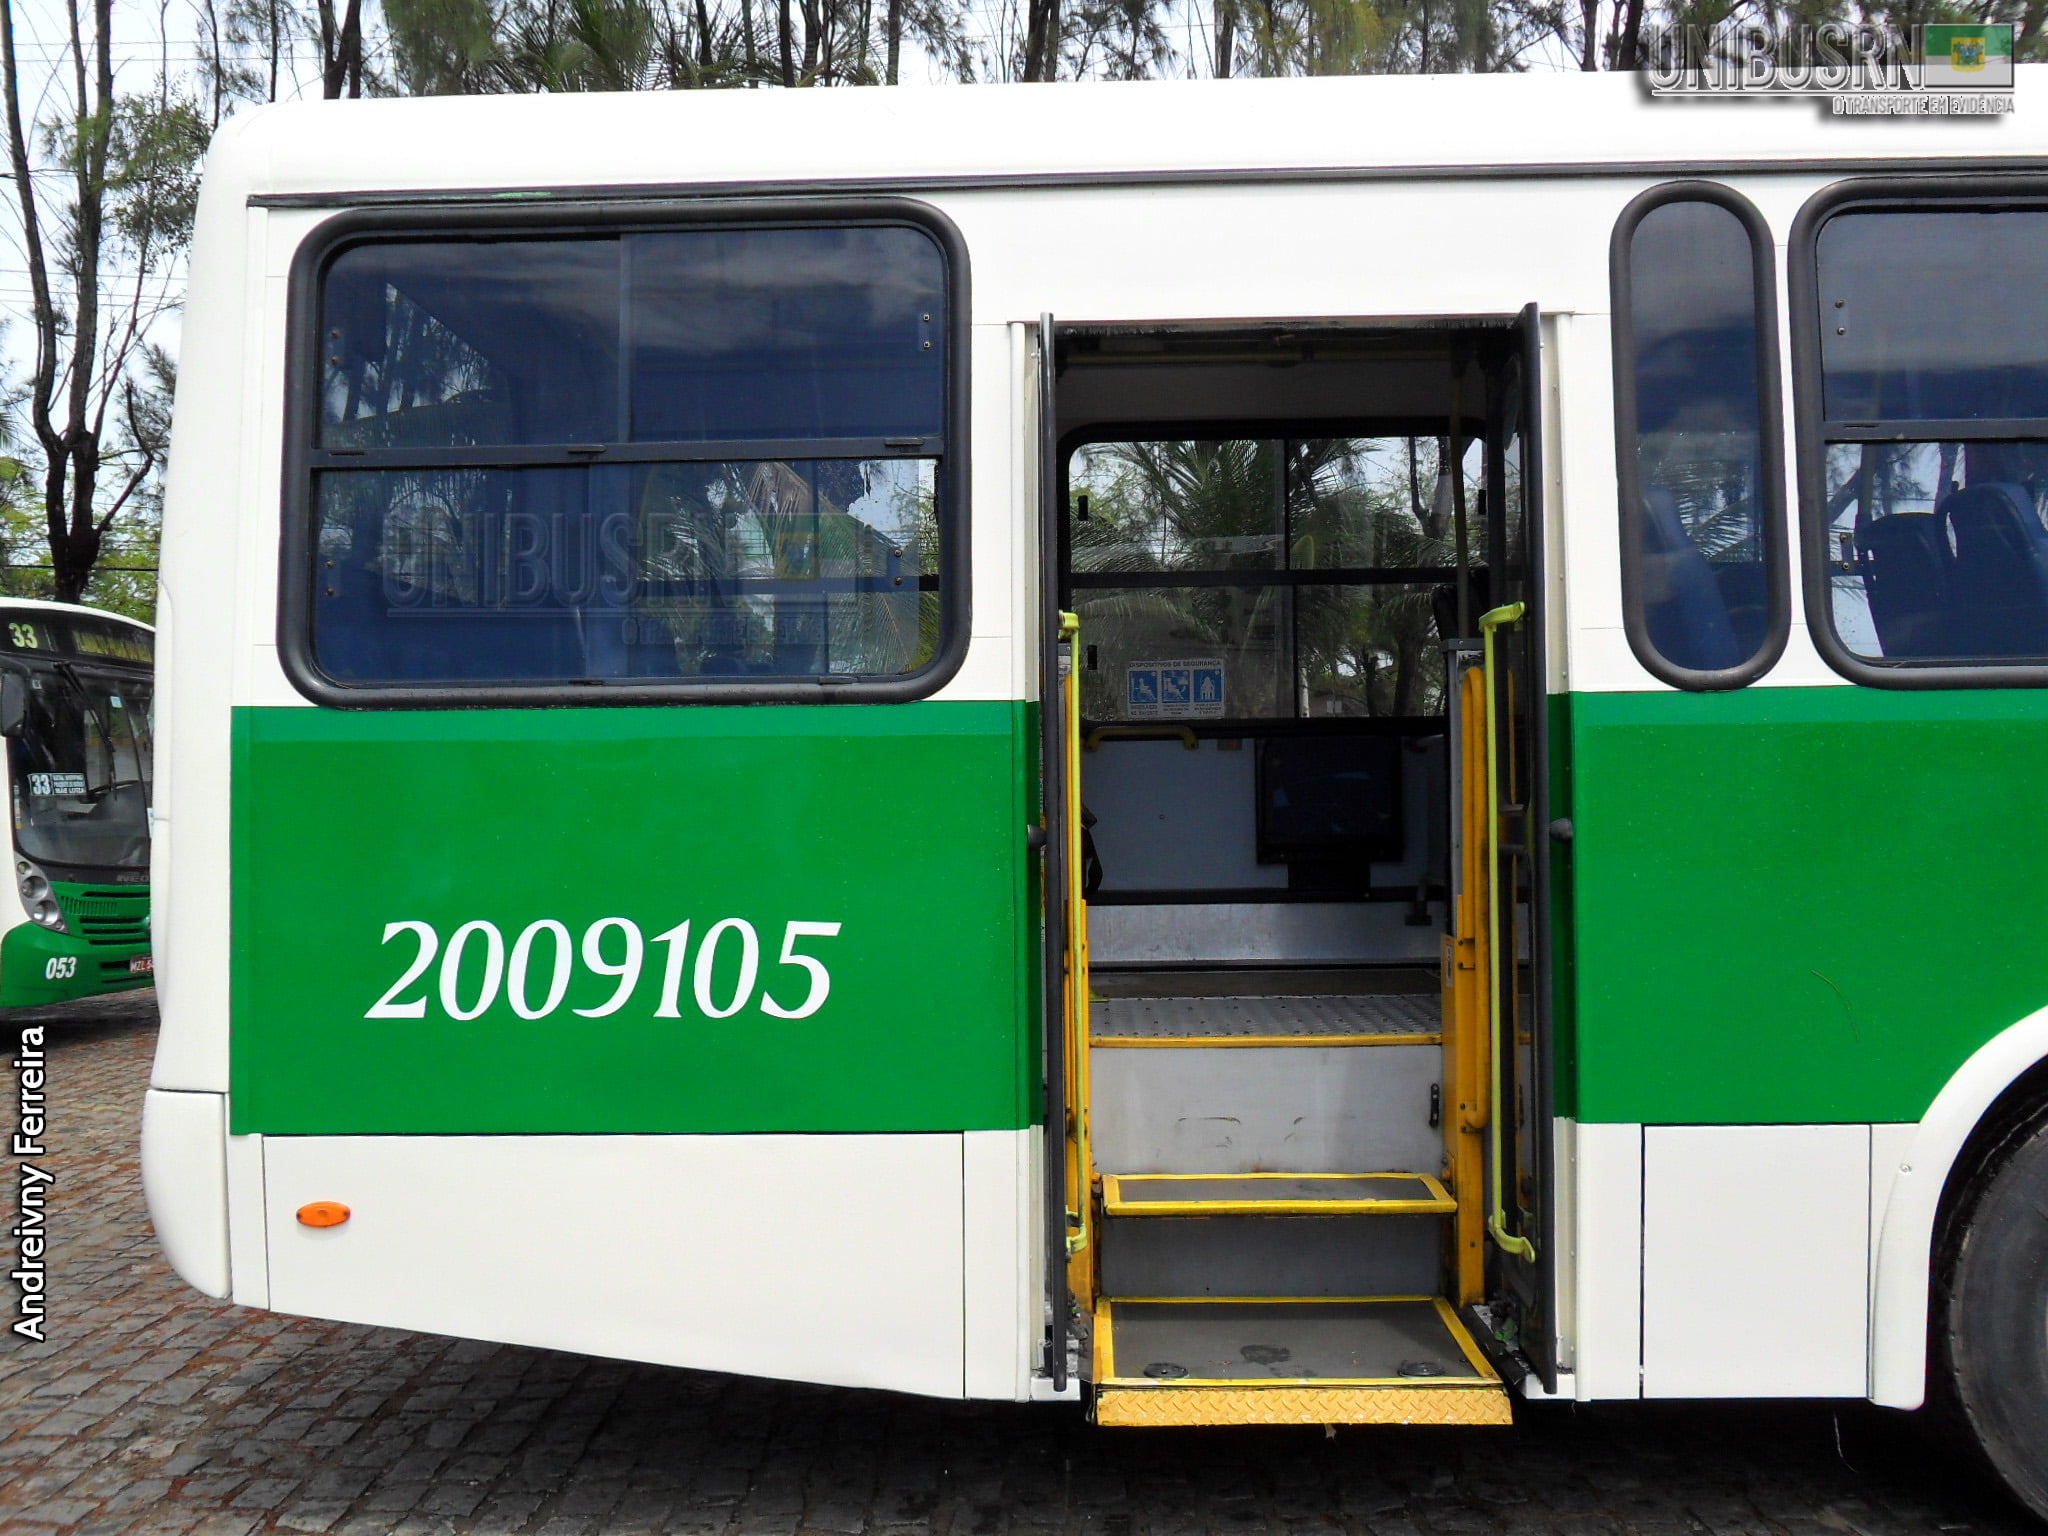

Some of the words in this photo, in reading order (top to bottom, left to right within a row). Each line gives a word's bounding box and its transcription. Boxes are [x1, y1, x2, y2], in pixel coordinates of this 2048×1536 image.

[8, 622, 38, 649] 33
[31, 774, 51, 795] 33
[45, 956, 77, 979] 053
[363, 917, 842, 1020] 2009105
